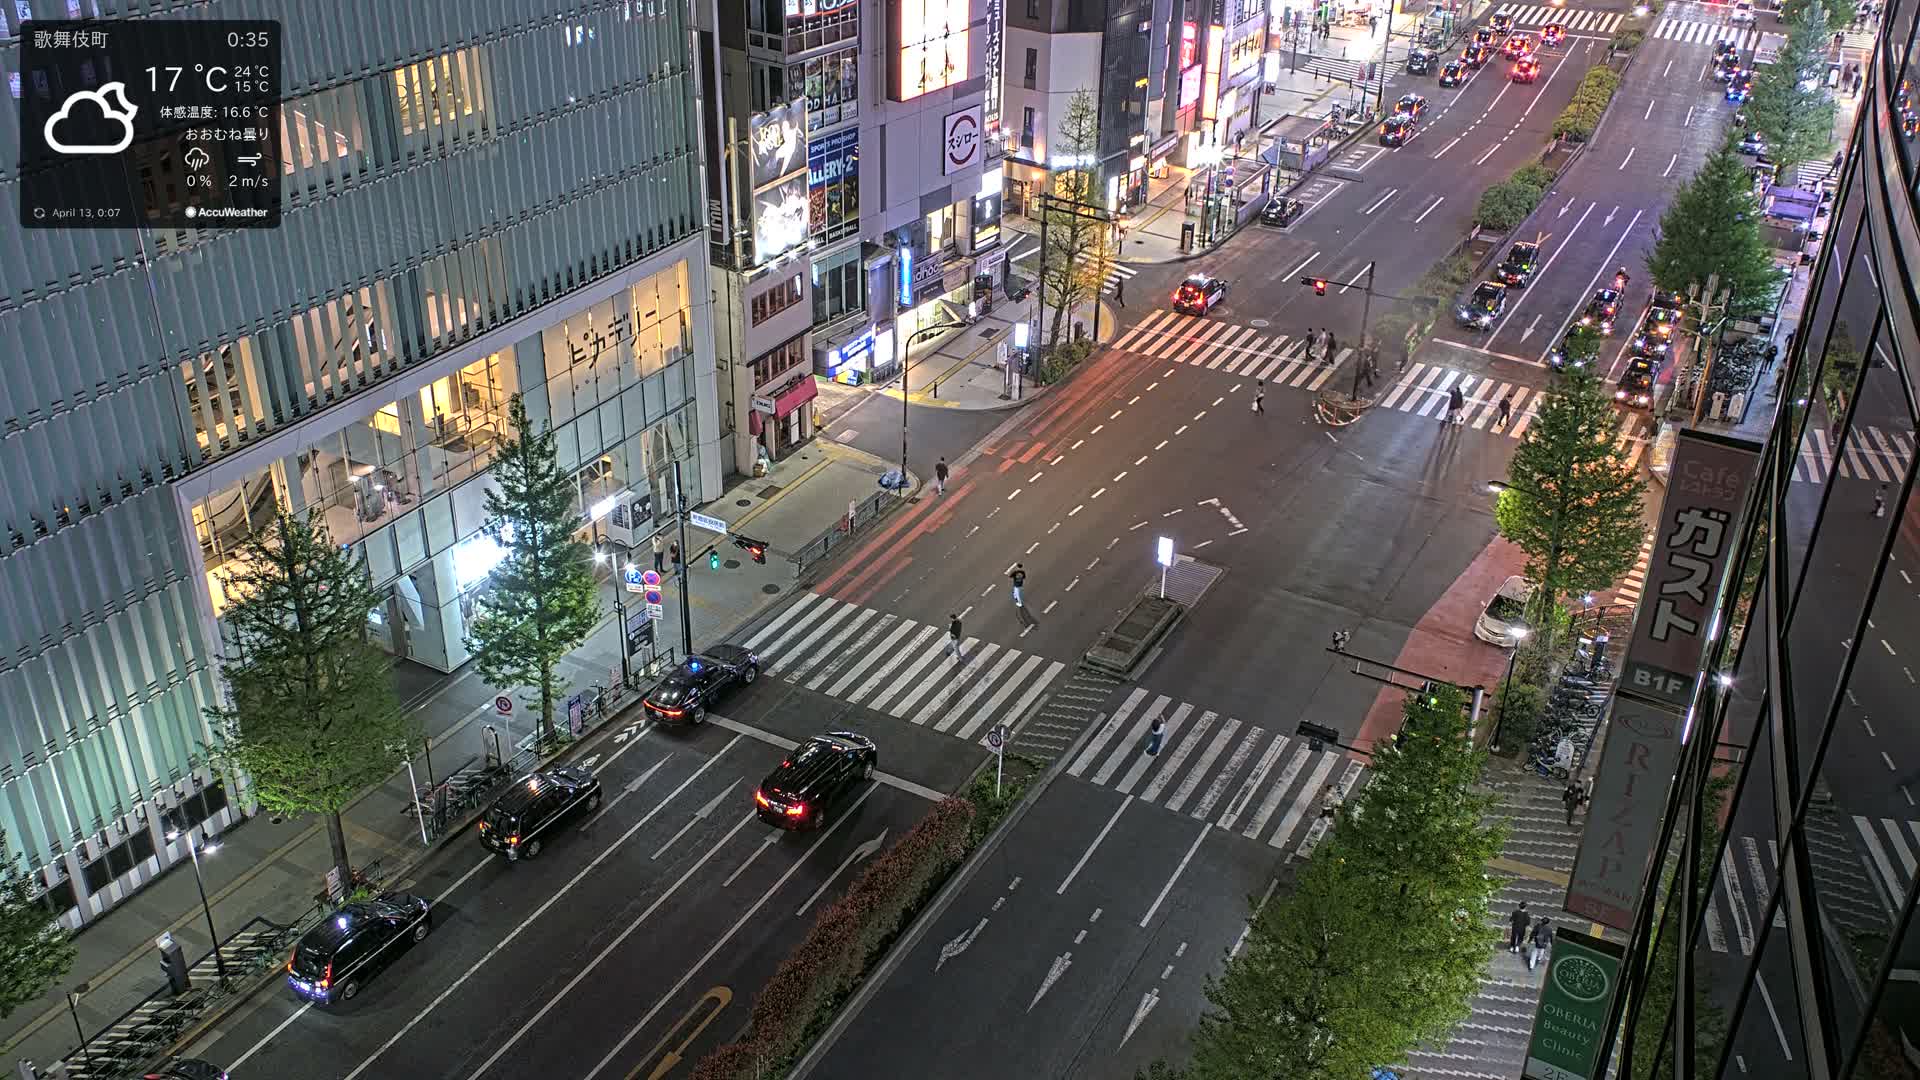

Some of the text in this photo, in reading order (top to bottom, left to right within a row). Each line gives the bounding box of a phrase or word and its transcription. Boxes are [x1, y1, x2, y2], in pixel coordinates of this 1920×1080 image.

[842, 132, 856, 143] SHOP
[947, 132, 979, 152] スシロー
[710, 199, 723, 232] MUJI
[570, 309, 657, 370] ピカデリー
[1651, 507, 1729, 641] ガスト
[1633, 667, 1683, 695] B1F
[1543, 1004, 1598, 1032] OBERIA
[1543, 1019, 1592, 1045] Beauty
[1543, 1038, 1583, 1060] Clinic
